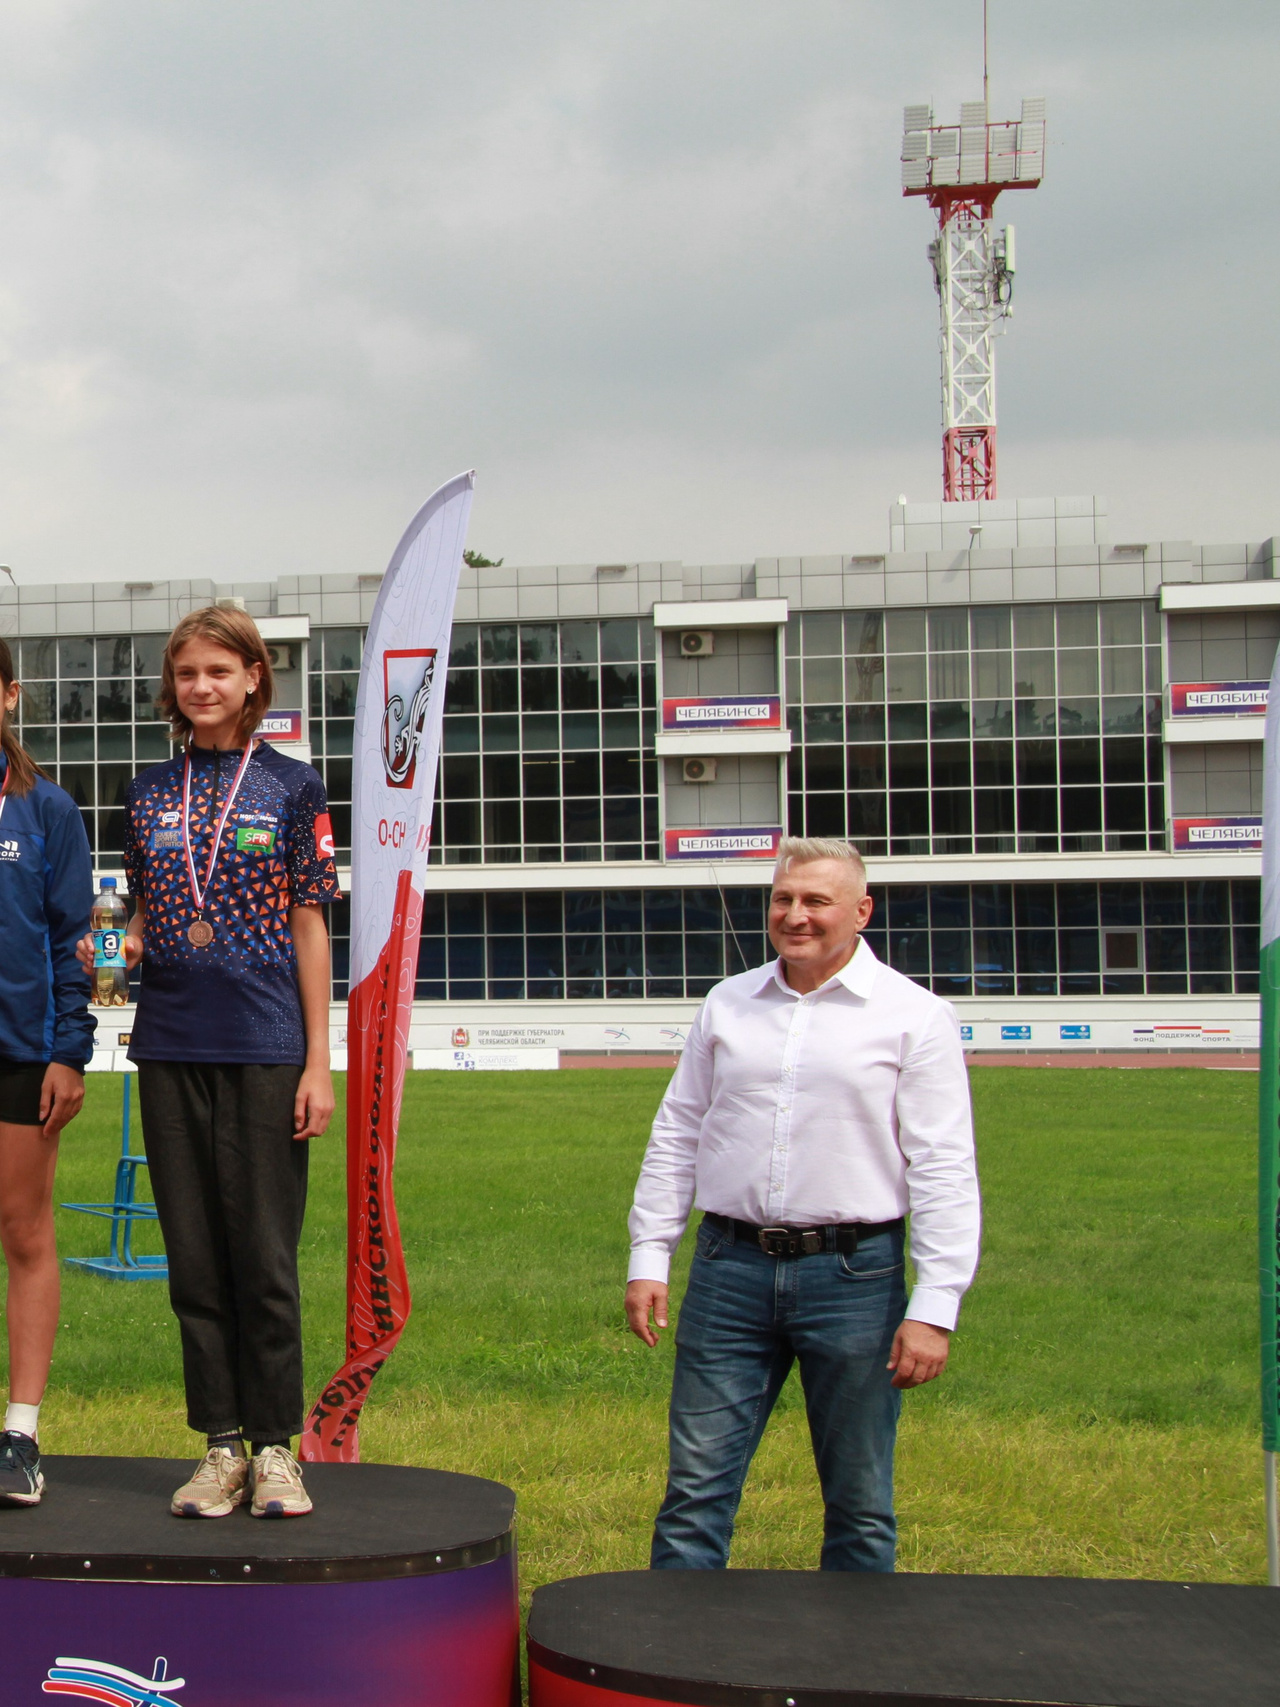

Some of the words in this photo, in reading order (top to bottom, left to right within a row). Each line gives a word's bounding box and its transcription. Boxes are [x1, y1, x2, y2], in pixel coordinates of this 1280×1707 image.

[678, 706, 768, 718] ЧЕЛЯБИНСК
[244, 832, 268, 845] SFR
[681, 837, 771, 849] ЧЕЛЯБИНСК
[491, 1029, 525, 1037] ПОДДЕРЖКЕ
